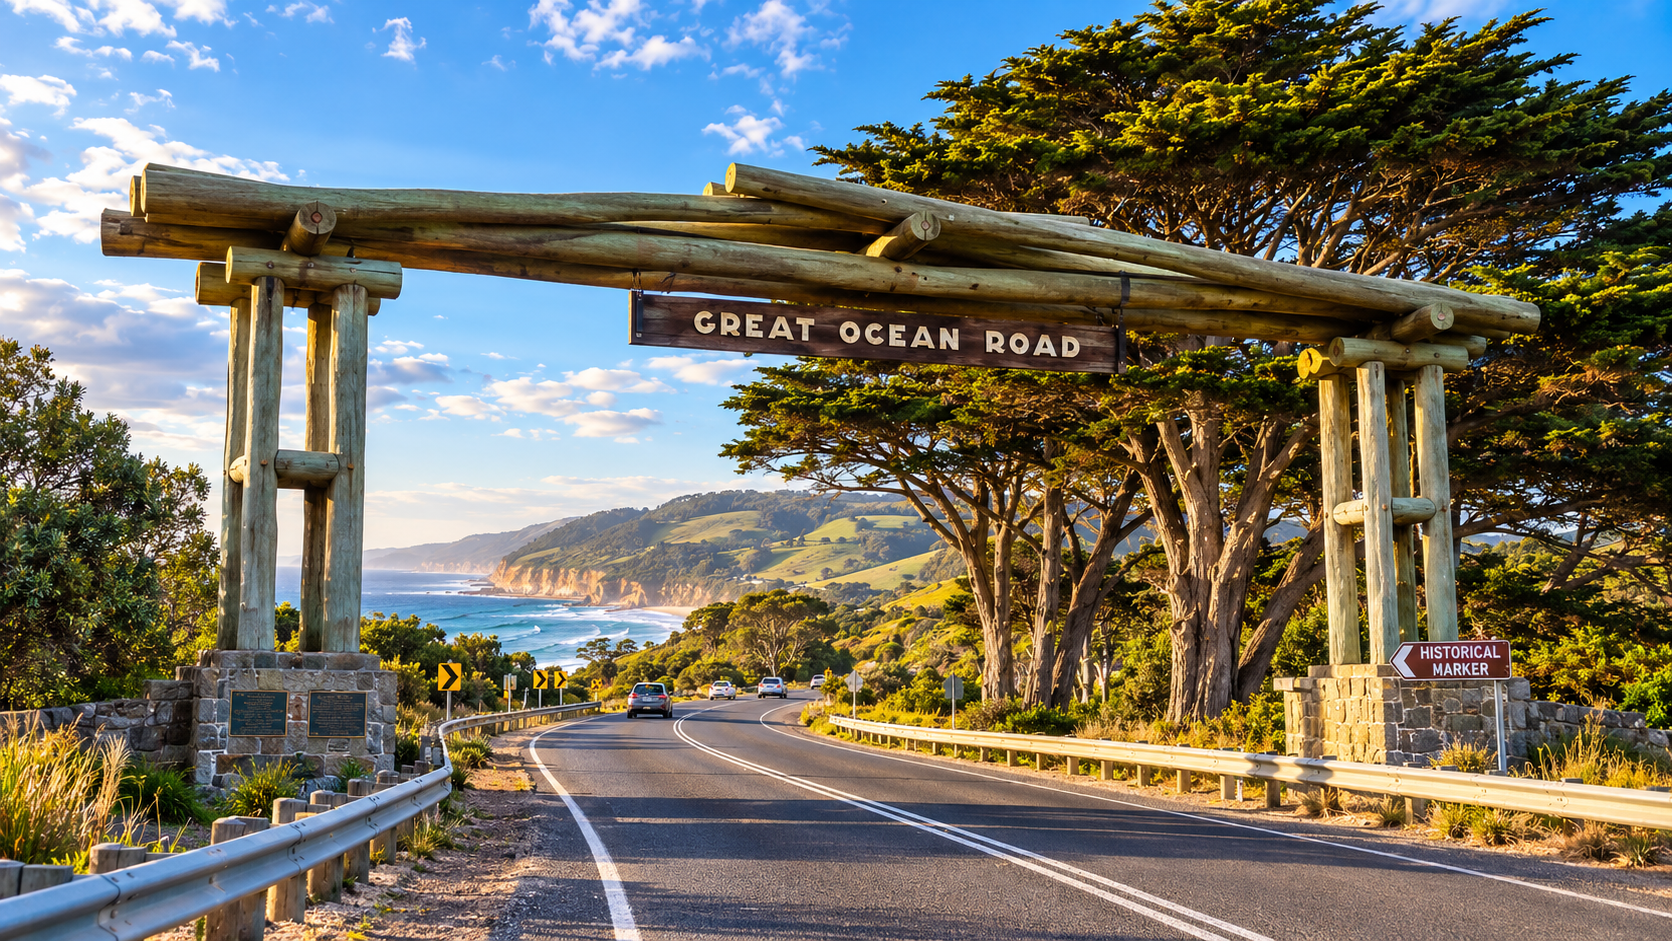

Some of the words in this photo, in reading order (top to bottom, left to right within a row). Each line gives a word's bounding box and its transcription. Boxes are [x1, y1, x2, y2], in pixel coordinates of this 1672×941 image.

[694, 310, 815, 342] GREAT
[839, 320, 959, 351] OCEAN
[985, 330, 1080, 358] ROAD
[1420, 645, 1501, 659] HISTORICAL
[1433, 662, 1489, 676] MARKER
